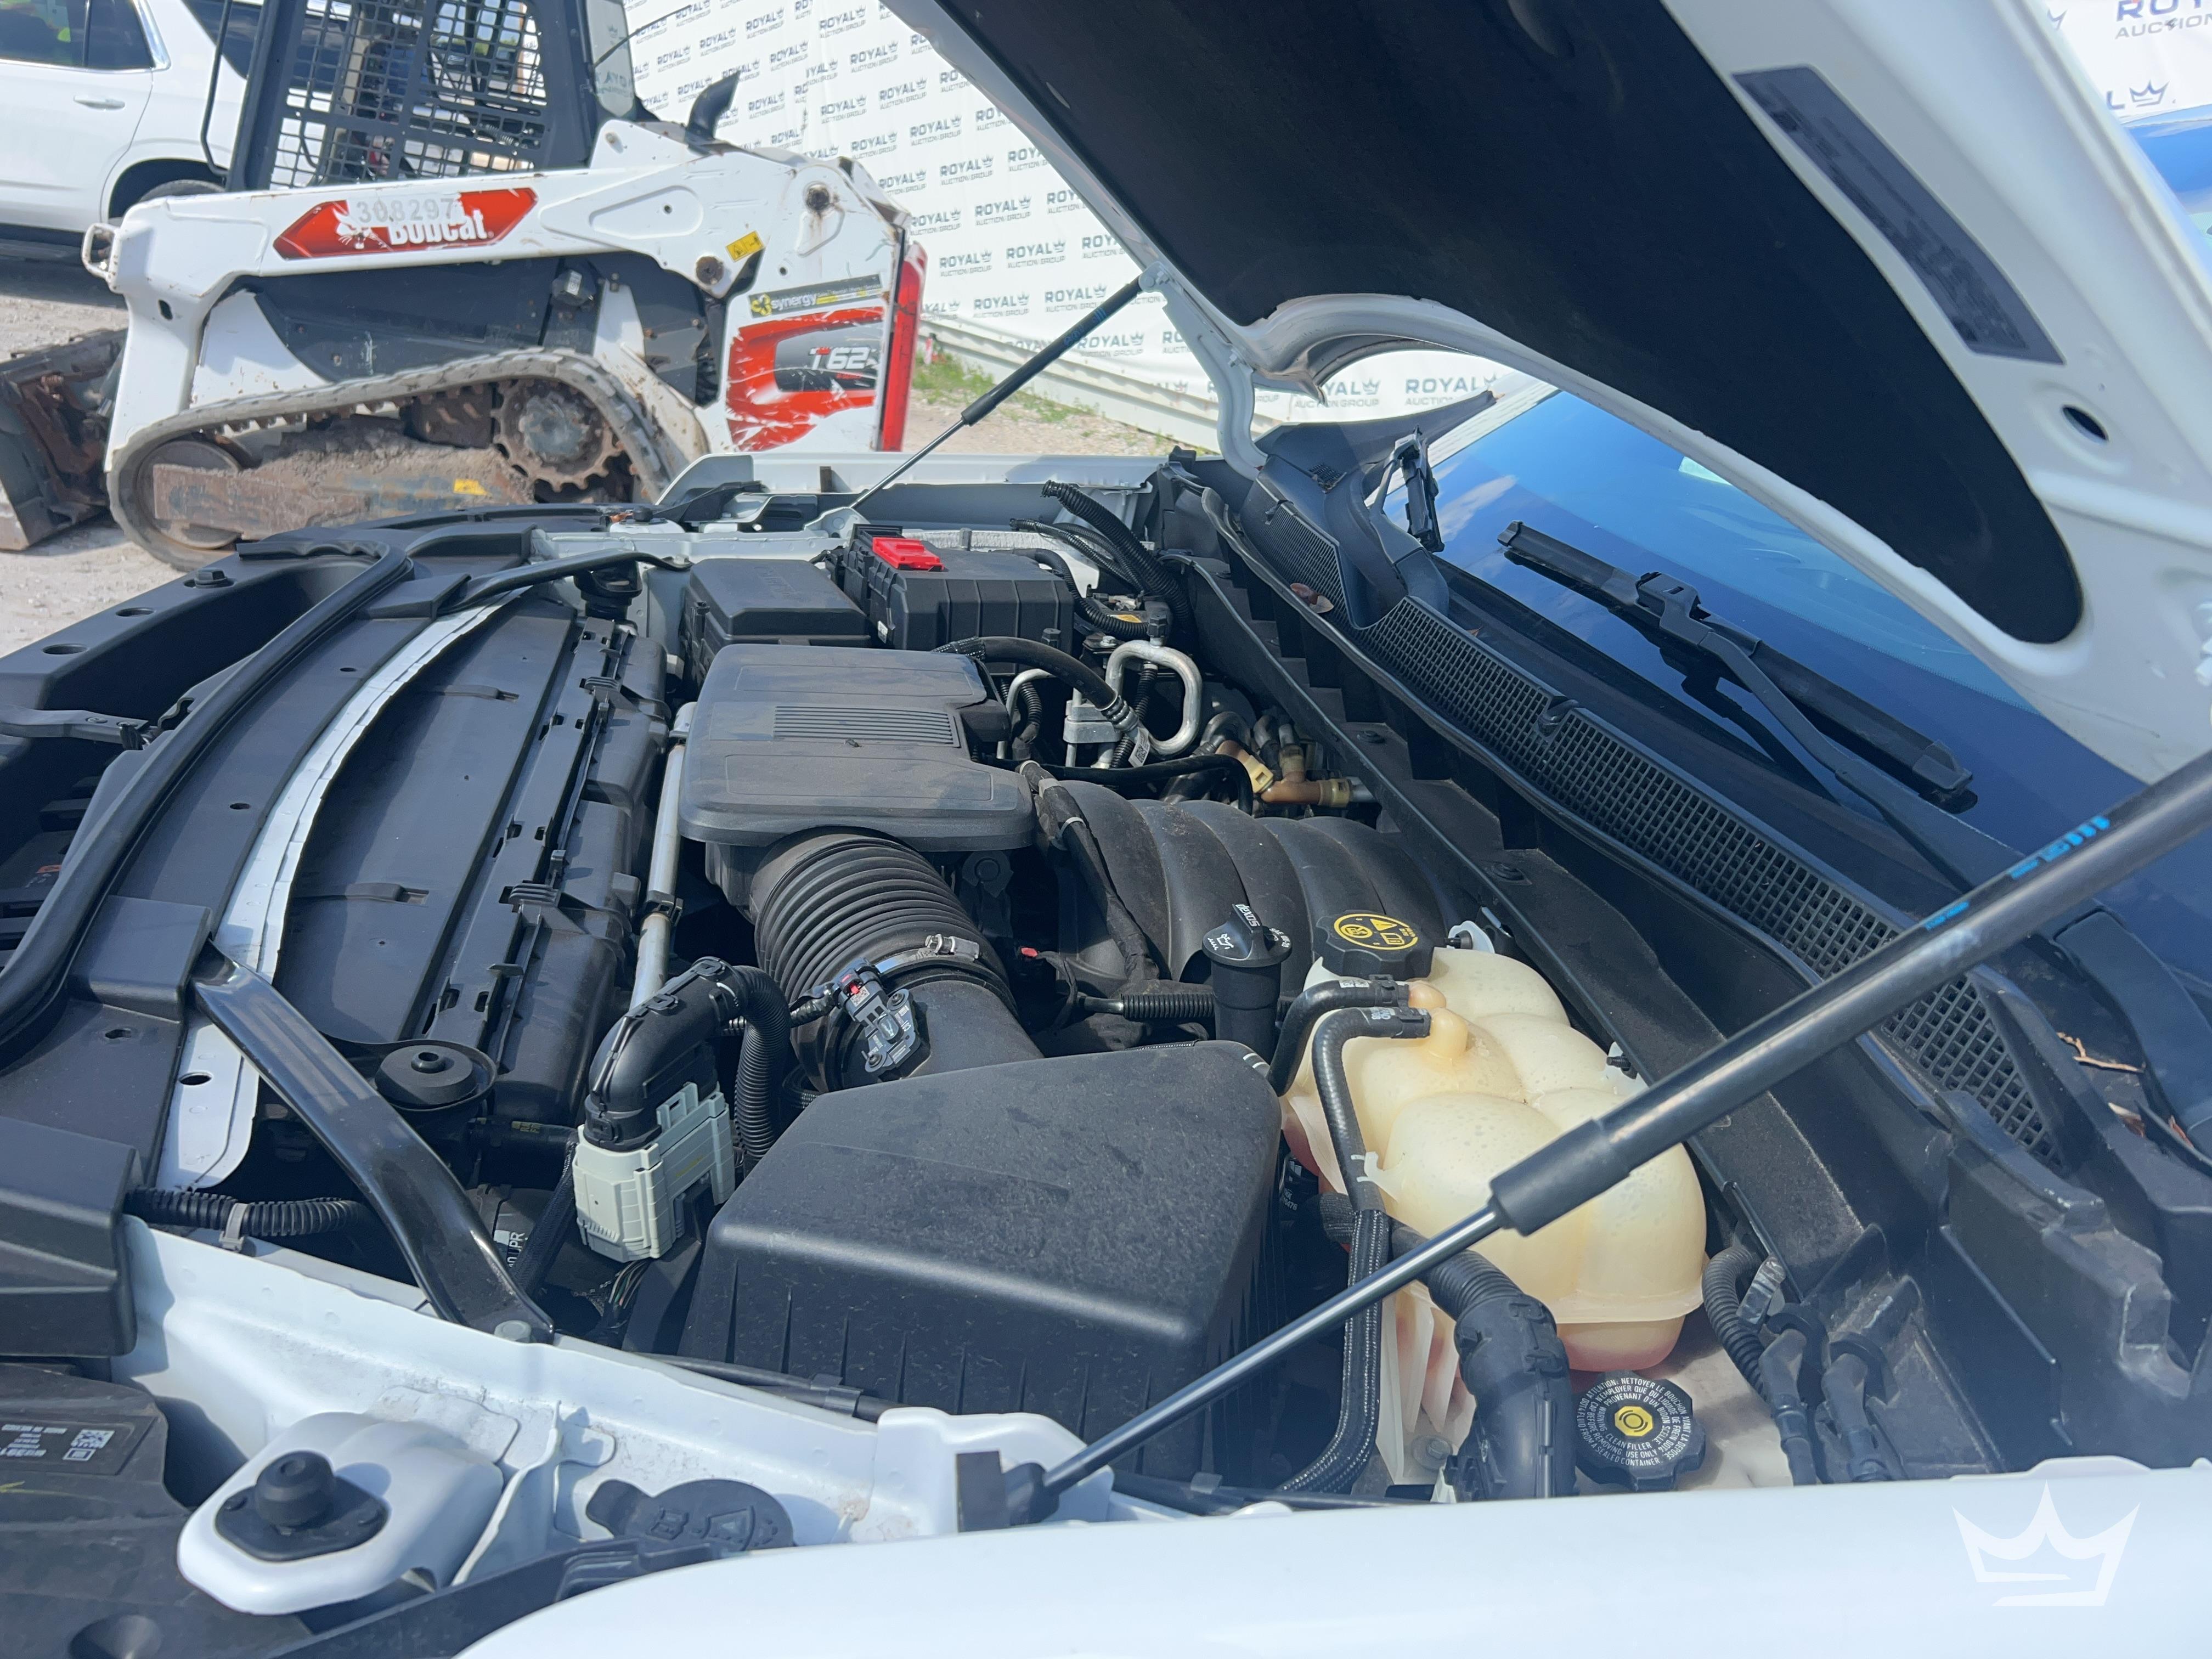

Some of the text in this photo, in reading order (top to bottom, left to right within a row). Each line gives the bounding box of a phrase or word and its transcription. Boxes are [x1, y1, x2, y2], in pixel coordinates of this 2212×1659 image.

[746, 12, 777, 31] ROYAL
[819, 10, 855, 31] ROYAL
[699, 32, 729, 49] ROYAL
[657, 49, 683, 66] ROYAL
[770, 44, 799, 64] ROYAL
[851, 44, 888, 65] ROYAL
[678, 80, 704, 95] ROYAL
[879, 82, 915, 101] ROYAL
[749, 94, 777, 111] ROYAL
[821, 96, 856, 116] ROYAL
[909, 118, 950, 138] ROYAL
[851, 133, 888, 153] ROYAL
[940, 159, 981, 177] ROYAL
[879, 171, 915, 189] ROYAL
[975, 198, 1018, 217] ROYAL
[911, 211, 950, 227] ROYAL
[1006, 242, 1054, 260] ROYAL
[939, 252, 980, 268] ROYAL
[771, 292, 818, 311] synergy
[973, 296, 1017, 311] ROYAL
[1045, 288, 1092, 304] ROYAL
[1077, 334, 1131, 349] ROYAL
[1405, 377, 1479, 394] ROYAL
[1340, 398, 1380, 408] GROUP
[1235, 904, 1261, 927] dexos
[1621, 1378, 1656, 1389] NETTOYER
[1634, 1385, 1648, 1395] QUE
[1656, 1385, 1666, 1393] LE
[1649, 1390, 1660, 1398] DU
[1664, 1390, 1687, 1415] BOUCHON
[1604, 1392, 1642, 1407] PROVENANT
[1657, 1406, 1671, 1424] BIDON
[1658, 1396, 1678, 1415] LIQUIDE
[1577, 1412, 1587, 1428] FLUID
[1671, 1416, 1681, 1424] DE
[1682, 1416, 1691, 1434] AVANT
[1580, 1427, 1595, 1444] FROM
[1587, 1401, 1658, 1459] CAP BEFORE REMOVING USE ONLY
[1669, 1425, 1681, 1441] FREIN
[1680, 1434, 1690, 1442] LA
[1605, 1433, 1627, 1449] CLEAN
[1627, 1441, 1652, 1451] FILLER
[1595, 1446, 1621, 1463] SEALED
